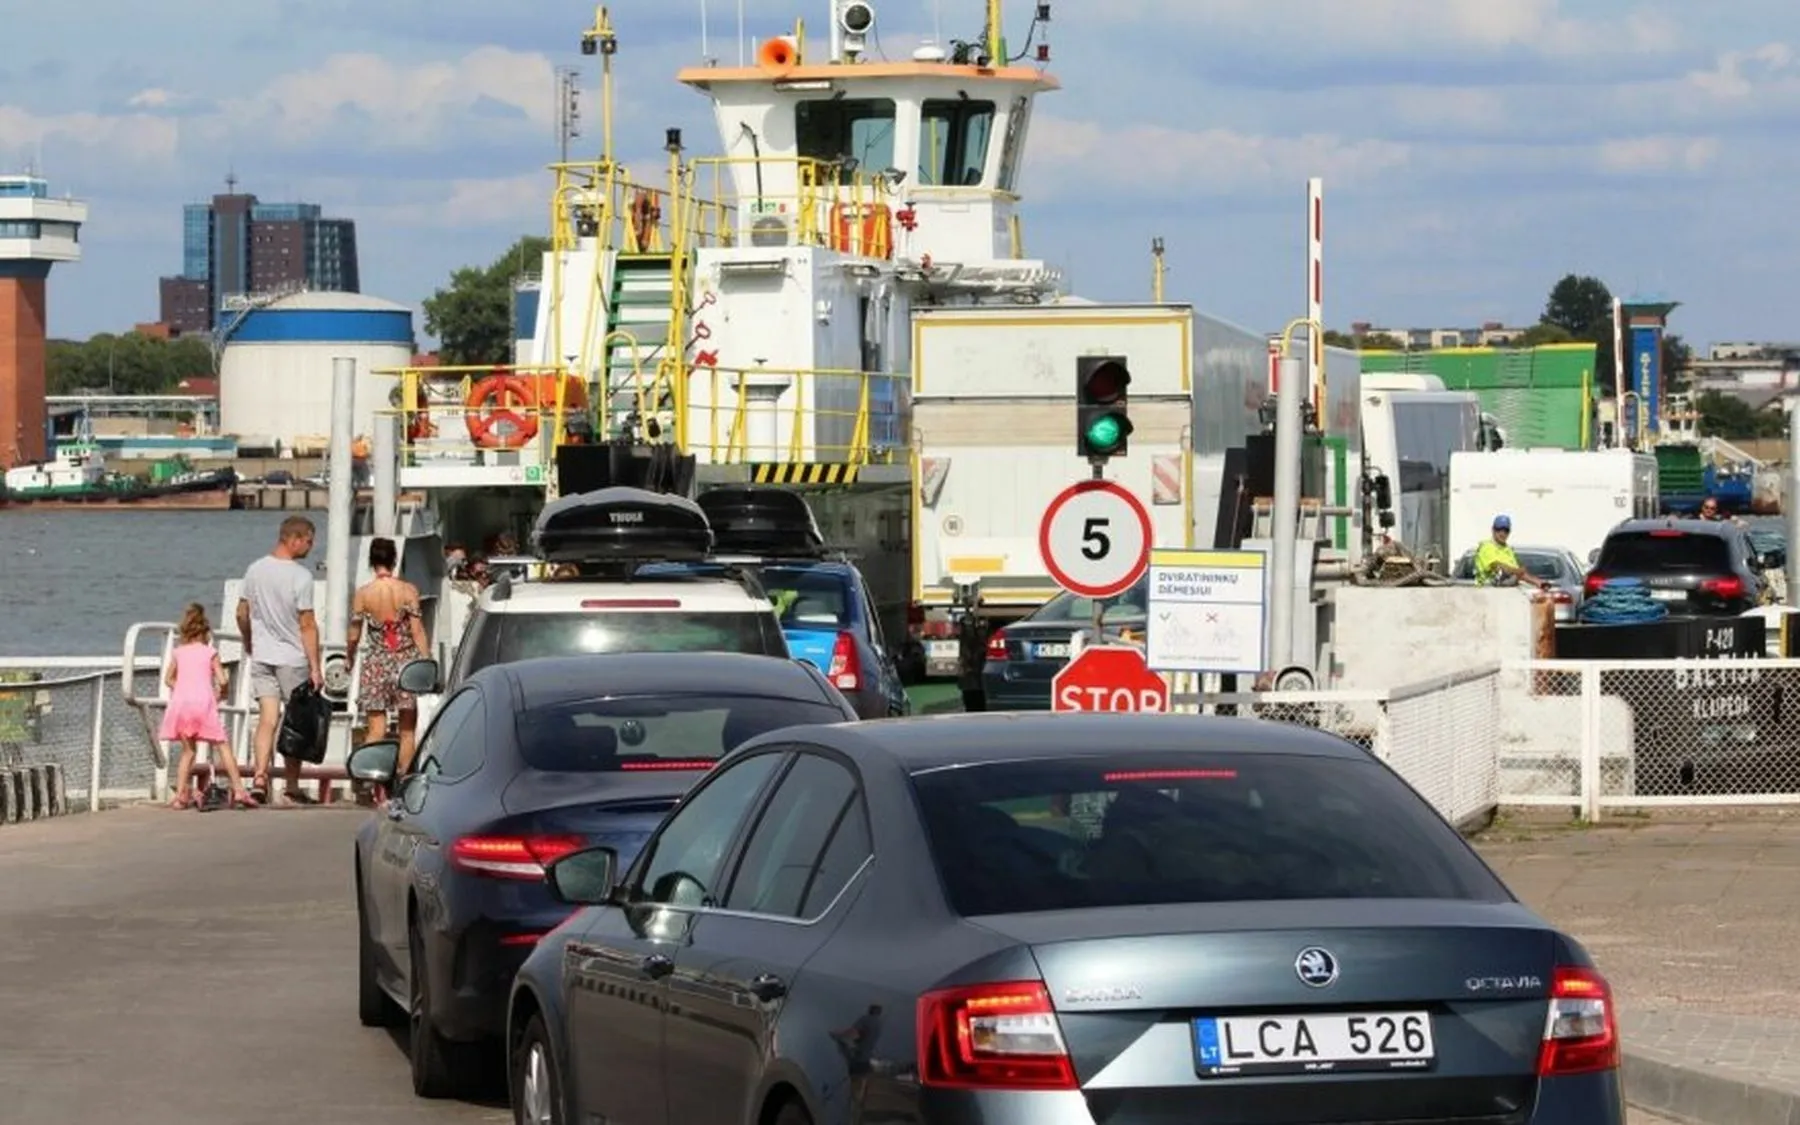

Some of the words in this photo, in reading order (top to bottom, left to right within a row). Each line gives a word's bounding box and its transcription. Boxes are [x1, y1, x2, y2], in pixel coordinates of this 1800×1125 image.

[1081, 518, 1110, 561] 5
[1060, 684, 1163, 712] STOP
[1465, 975, 1542, 991] OCTAVIA
[1223, 1018, 1318, 1058] LCA
[1347, 1015, 1426, 1054] 526
[1200, 1047, 1217, 1059] LT
